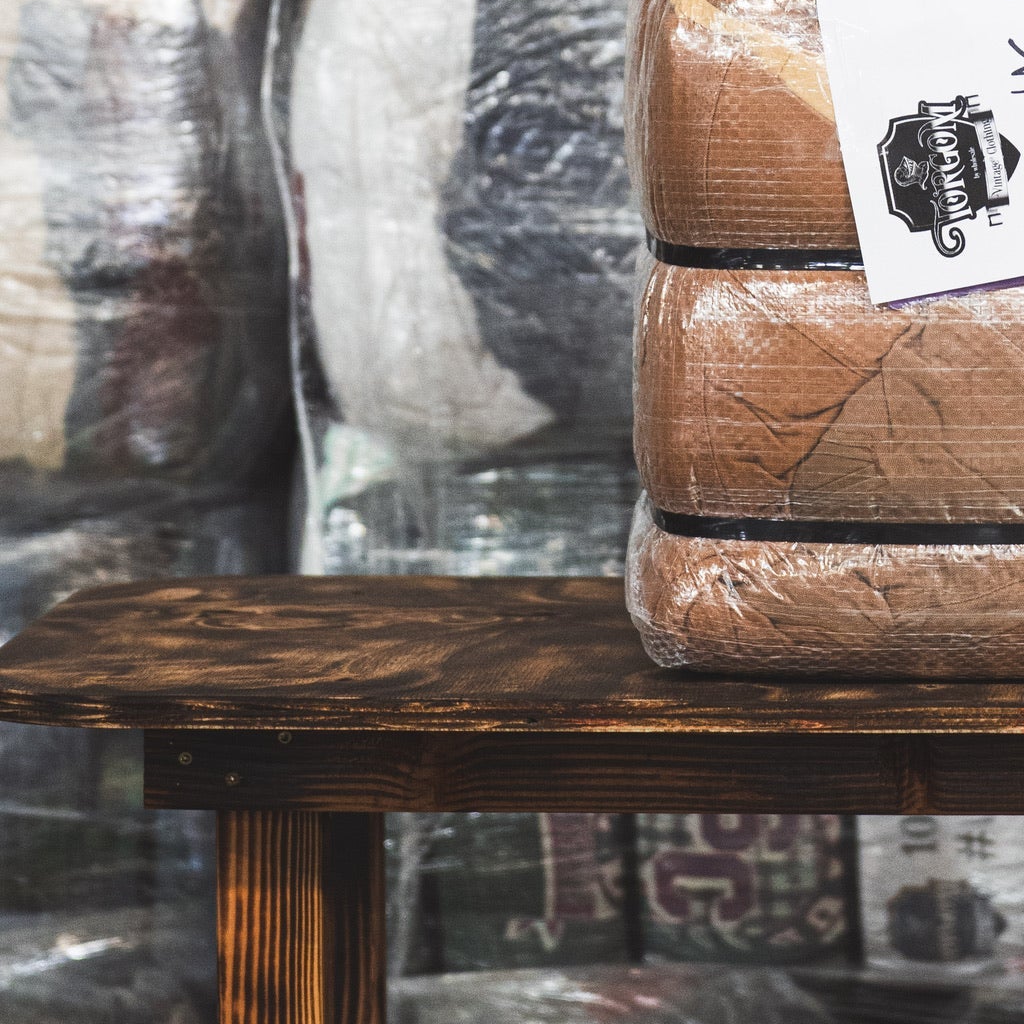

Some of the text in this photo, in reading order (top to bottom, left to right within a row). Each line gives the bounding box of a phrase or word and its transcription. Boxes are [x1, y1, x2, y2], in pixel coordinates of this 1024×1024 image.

[917, 94, 978, 258] TORGOM
[980, 117, 1004, 199] Vintage Clothing
